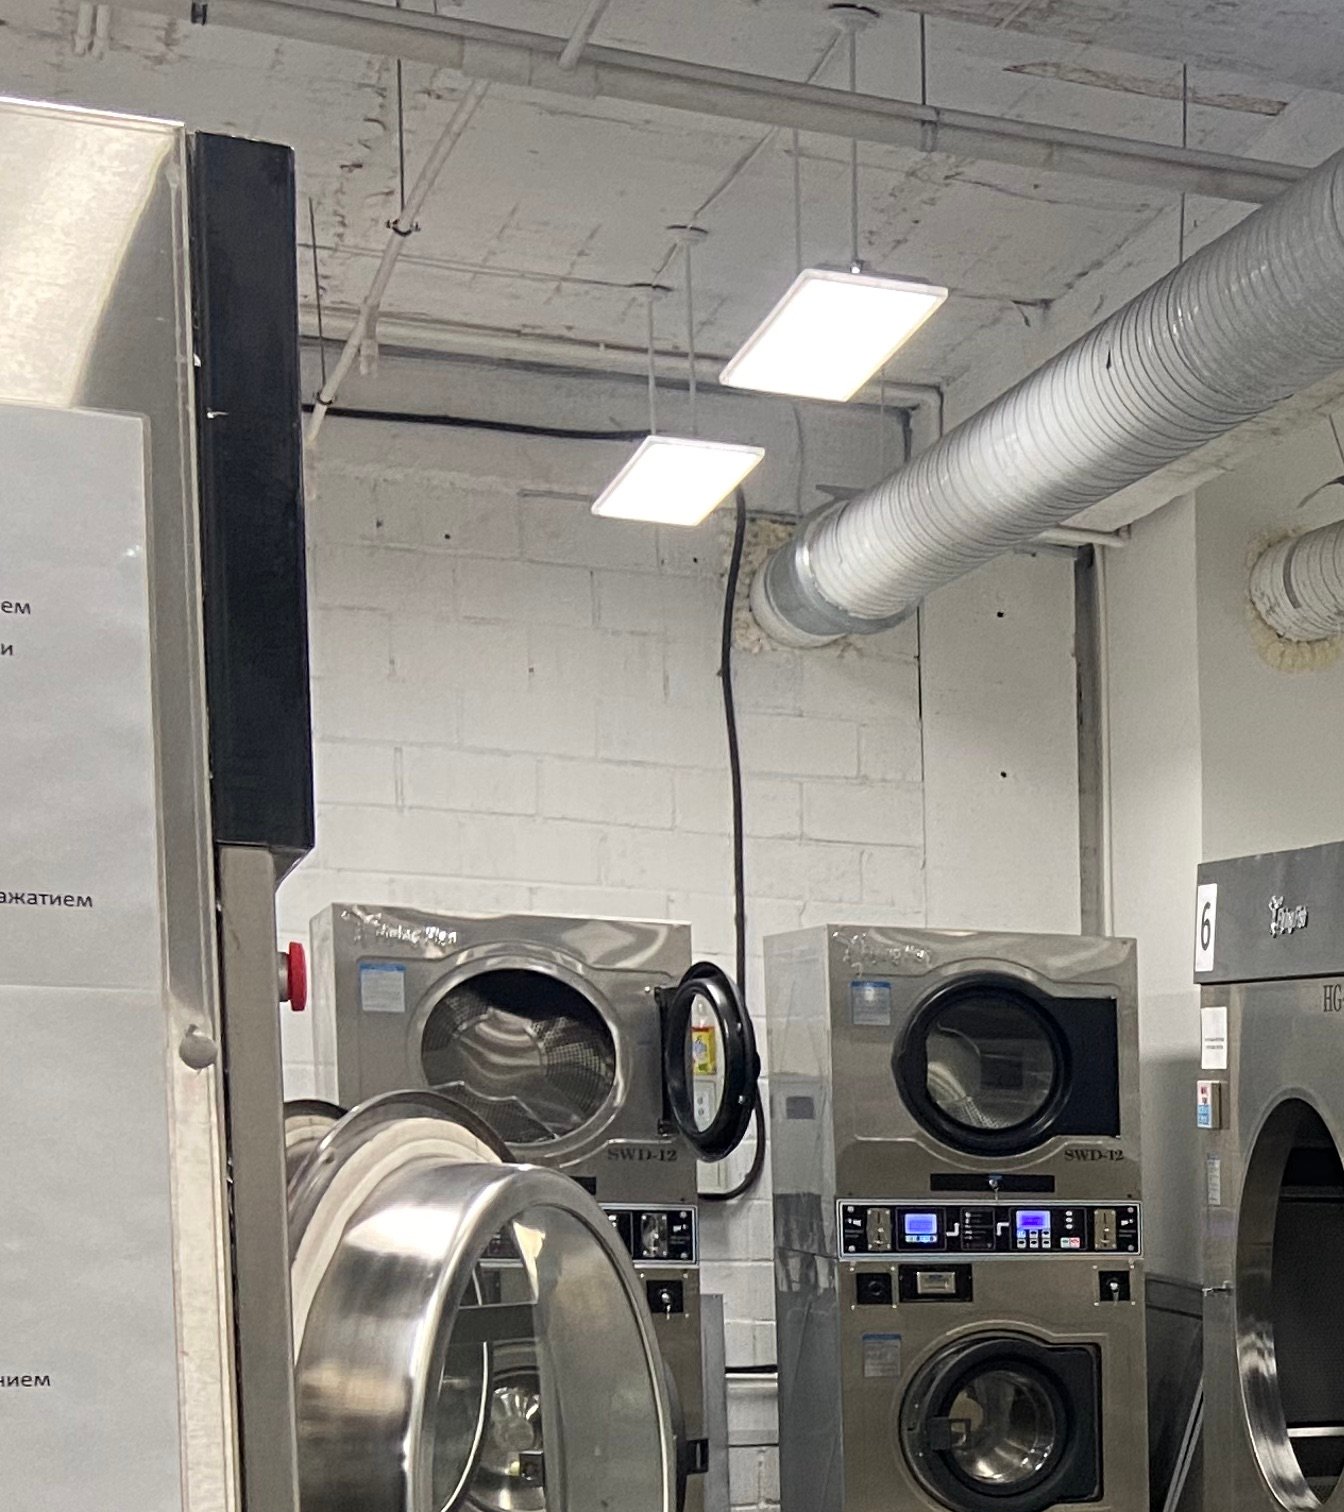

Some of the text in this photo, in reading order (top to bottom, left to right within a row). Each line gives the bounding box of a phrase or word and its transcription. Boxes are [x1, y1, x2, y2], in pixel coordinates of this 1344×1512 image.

[0, 891, 93, 908] ажатием
[1200, 901, 1212, 951] 6
[607, 1147, 678, 1162] SWD-12
[1064, 1148, 1125, 1161] SWD-12
